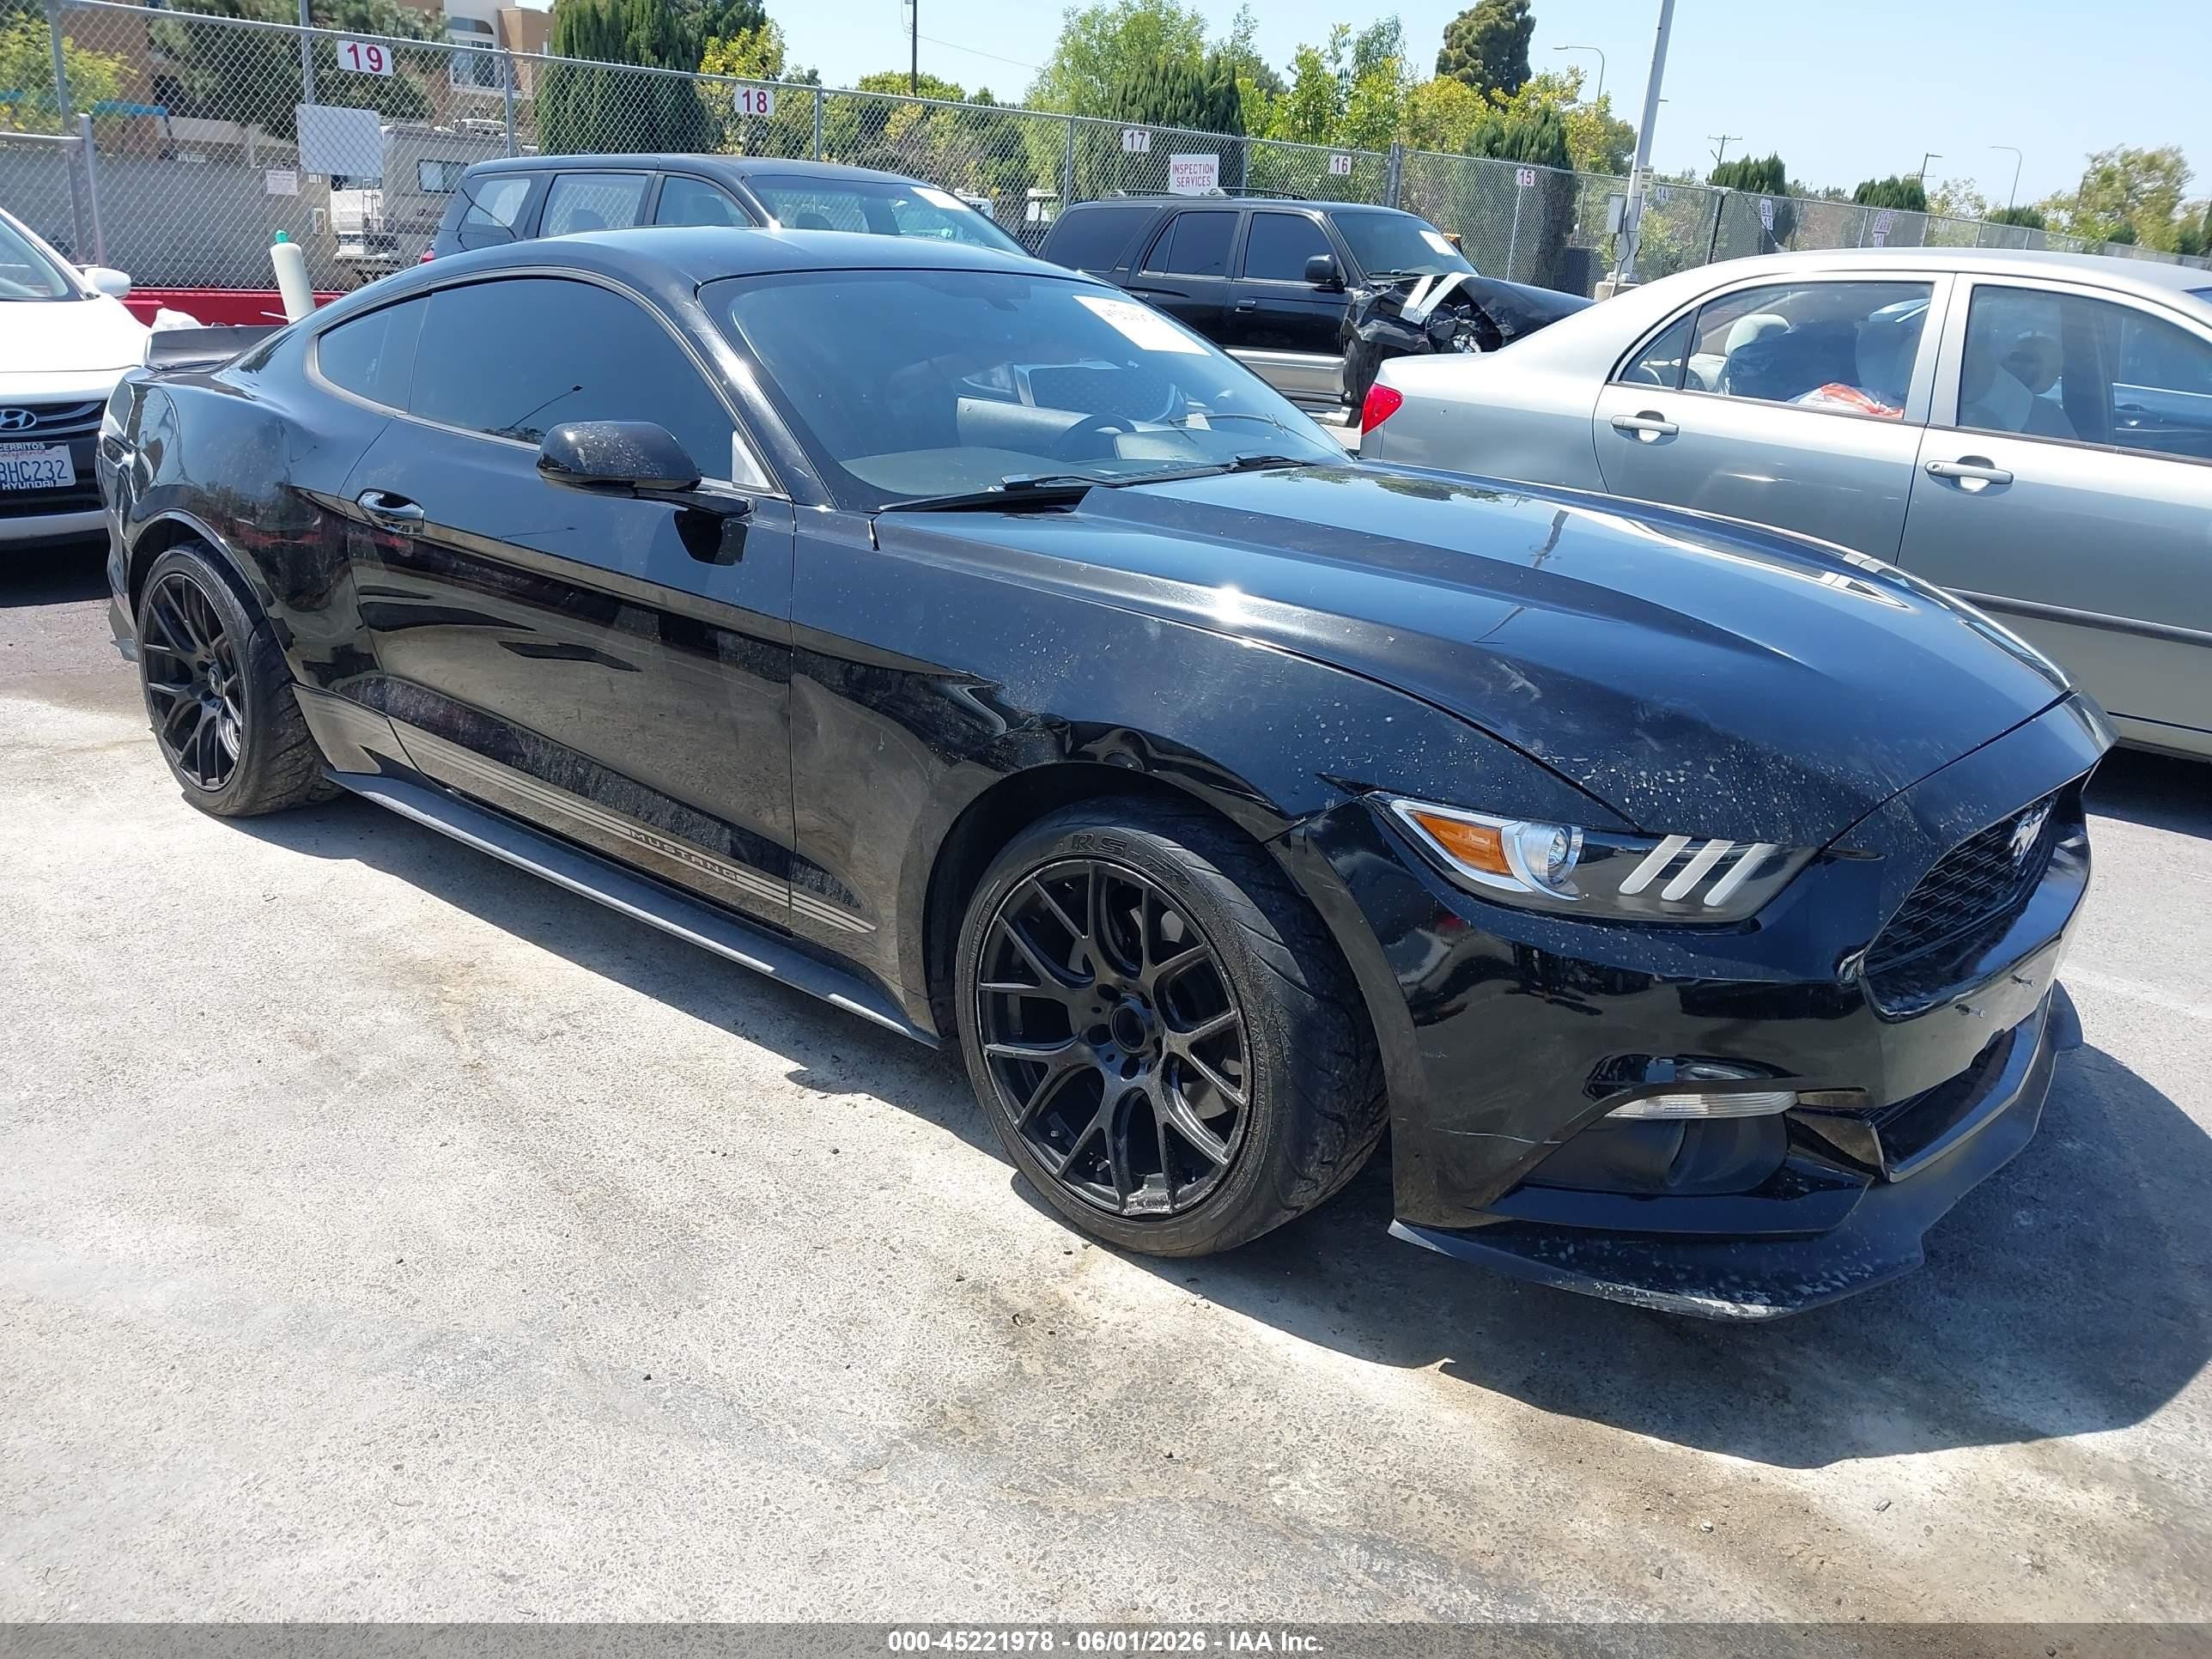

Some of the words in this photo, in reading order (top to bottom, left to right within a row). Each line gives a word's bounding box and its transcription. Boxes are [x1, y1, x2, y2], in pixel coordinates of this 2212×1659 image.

[347, 44, 383, 72] 19
[742, 89, 768, 113] 18
[1129, 131, 1146, 150] 17
[1172, 163, 1214, 174] INSPECTION
[1334, 157, 1348, 173] 16
[1176, 175, 1211, 187] SERVICES
[1520, 170, 1532, 185] 15
[1658, 187, 1668, 201] 14
[2, 481, 55, 490] HYUNDAI
[631, 830, 737, 880] MUSTANG
